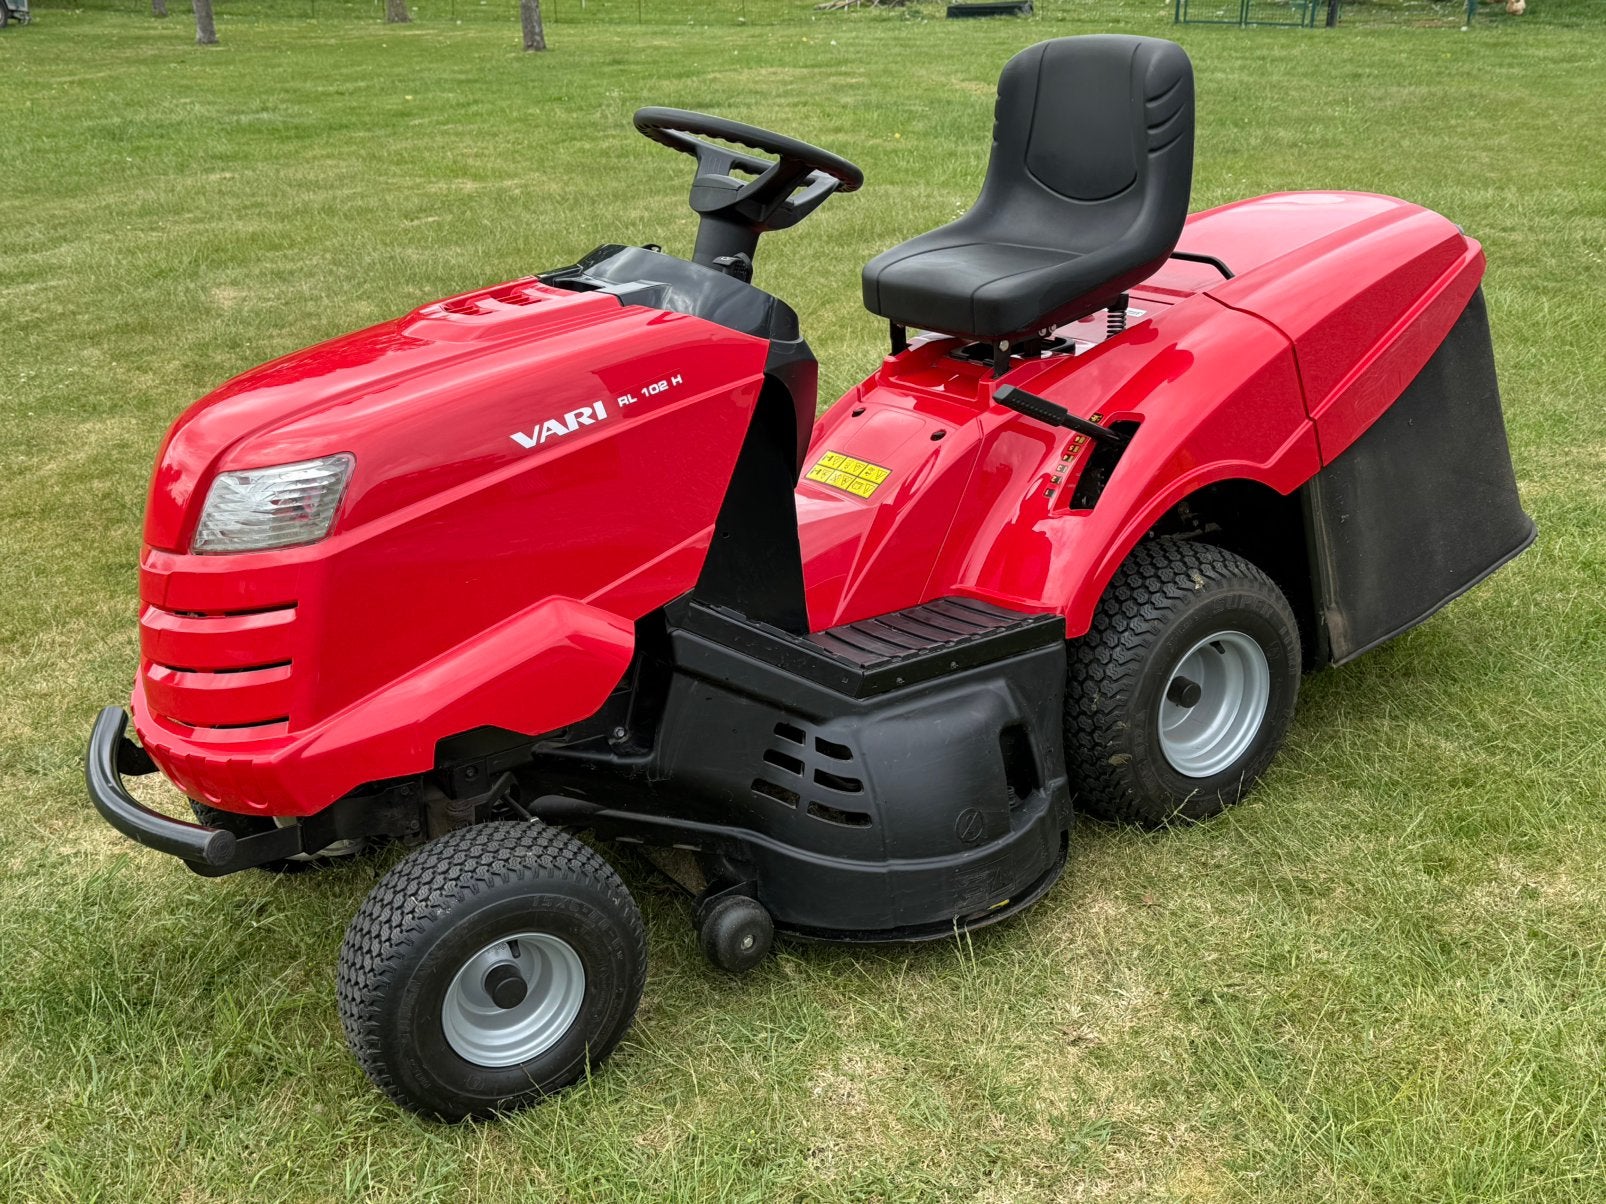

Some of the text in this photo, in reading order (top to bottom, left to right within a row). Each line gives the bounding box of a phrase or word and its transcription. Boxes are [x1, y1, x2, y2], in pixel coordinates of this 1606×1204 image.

[509, 374, 683, 449] VARI RL 102 H
